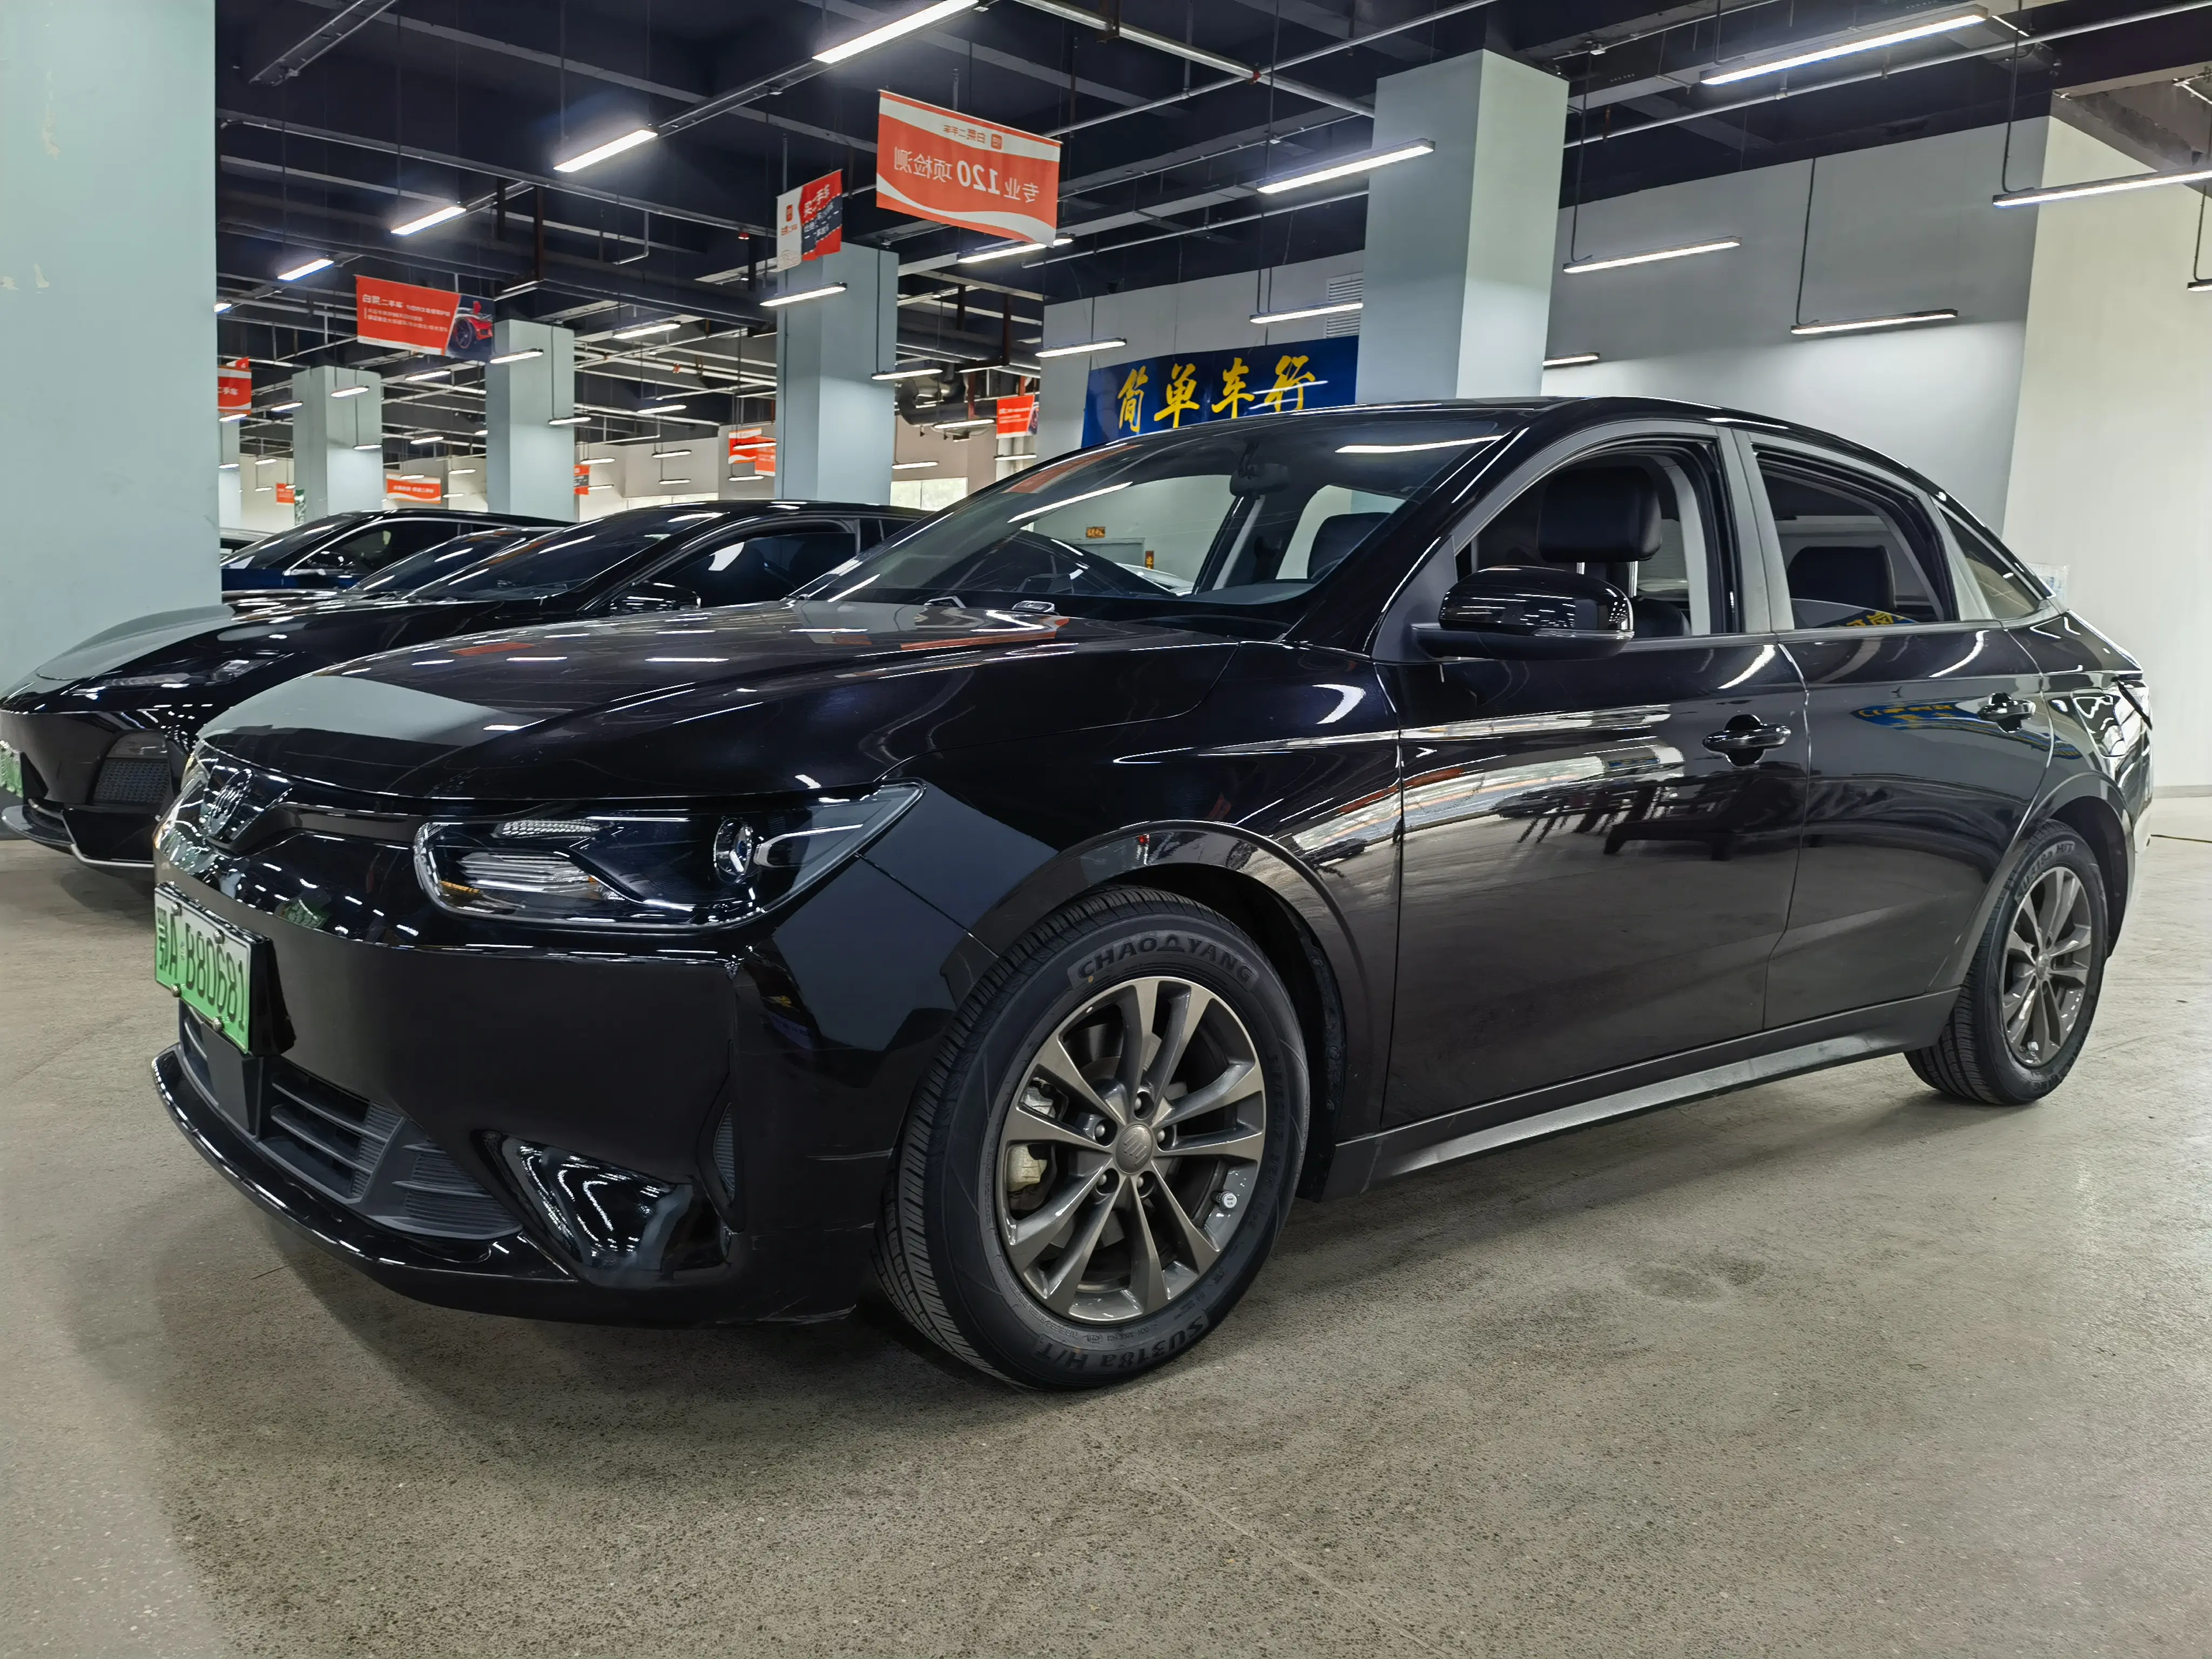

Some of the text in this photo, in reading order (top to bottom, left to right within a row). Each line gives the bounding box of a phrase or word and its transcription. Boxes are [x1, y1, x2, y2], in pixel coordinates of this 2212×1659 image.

[1117, 355, 1316, 433] 简单车行
[185, 922, 245, 1032] B80681
[1100, 1316, 1203, 1368] SU318a
